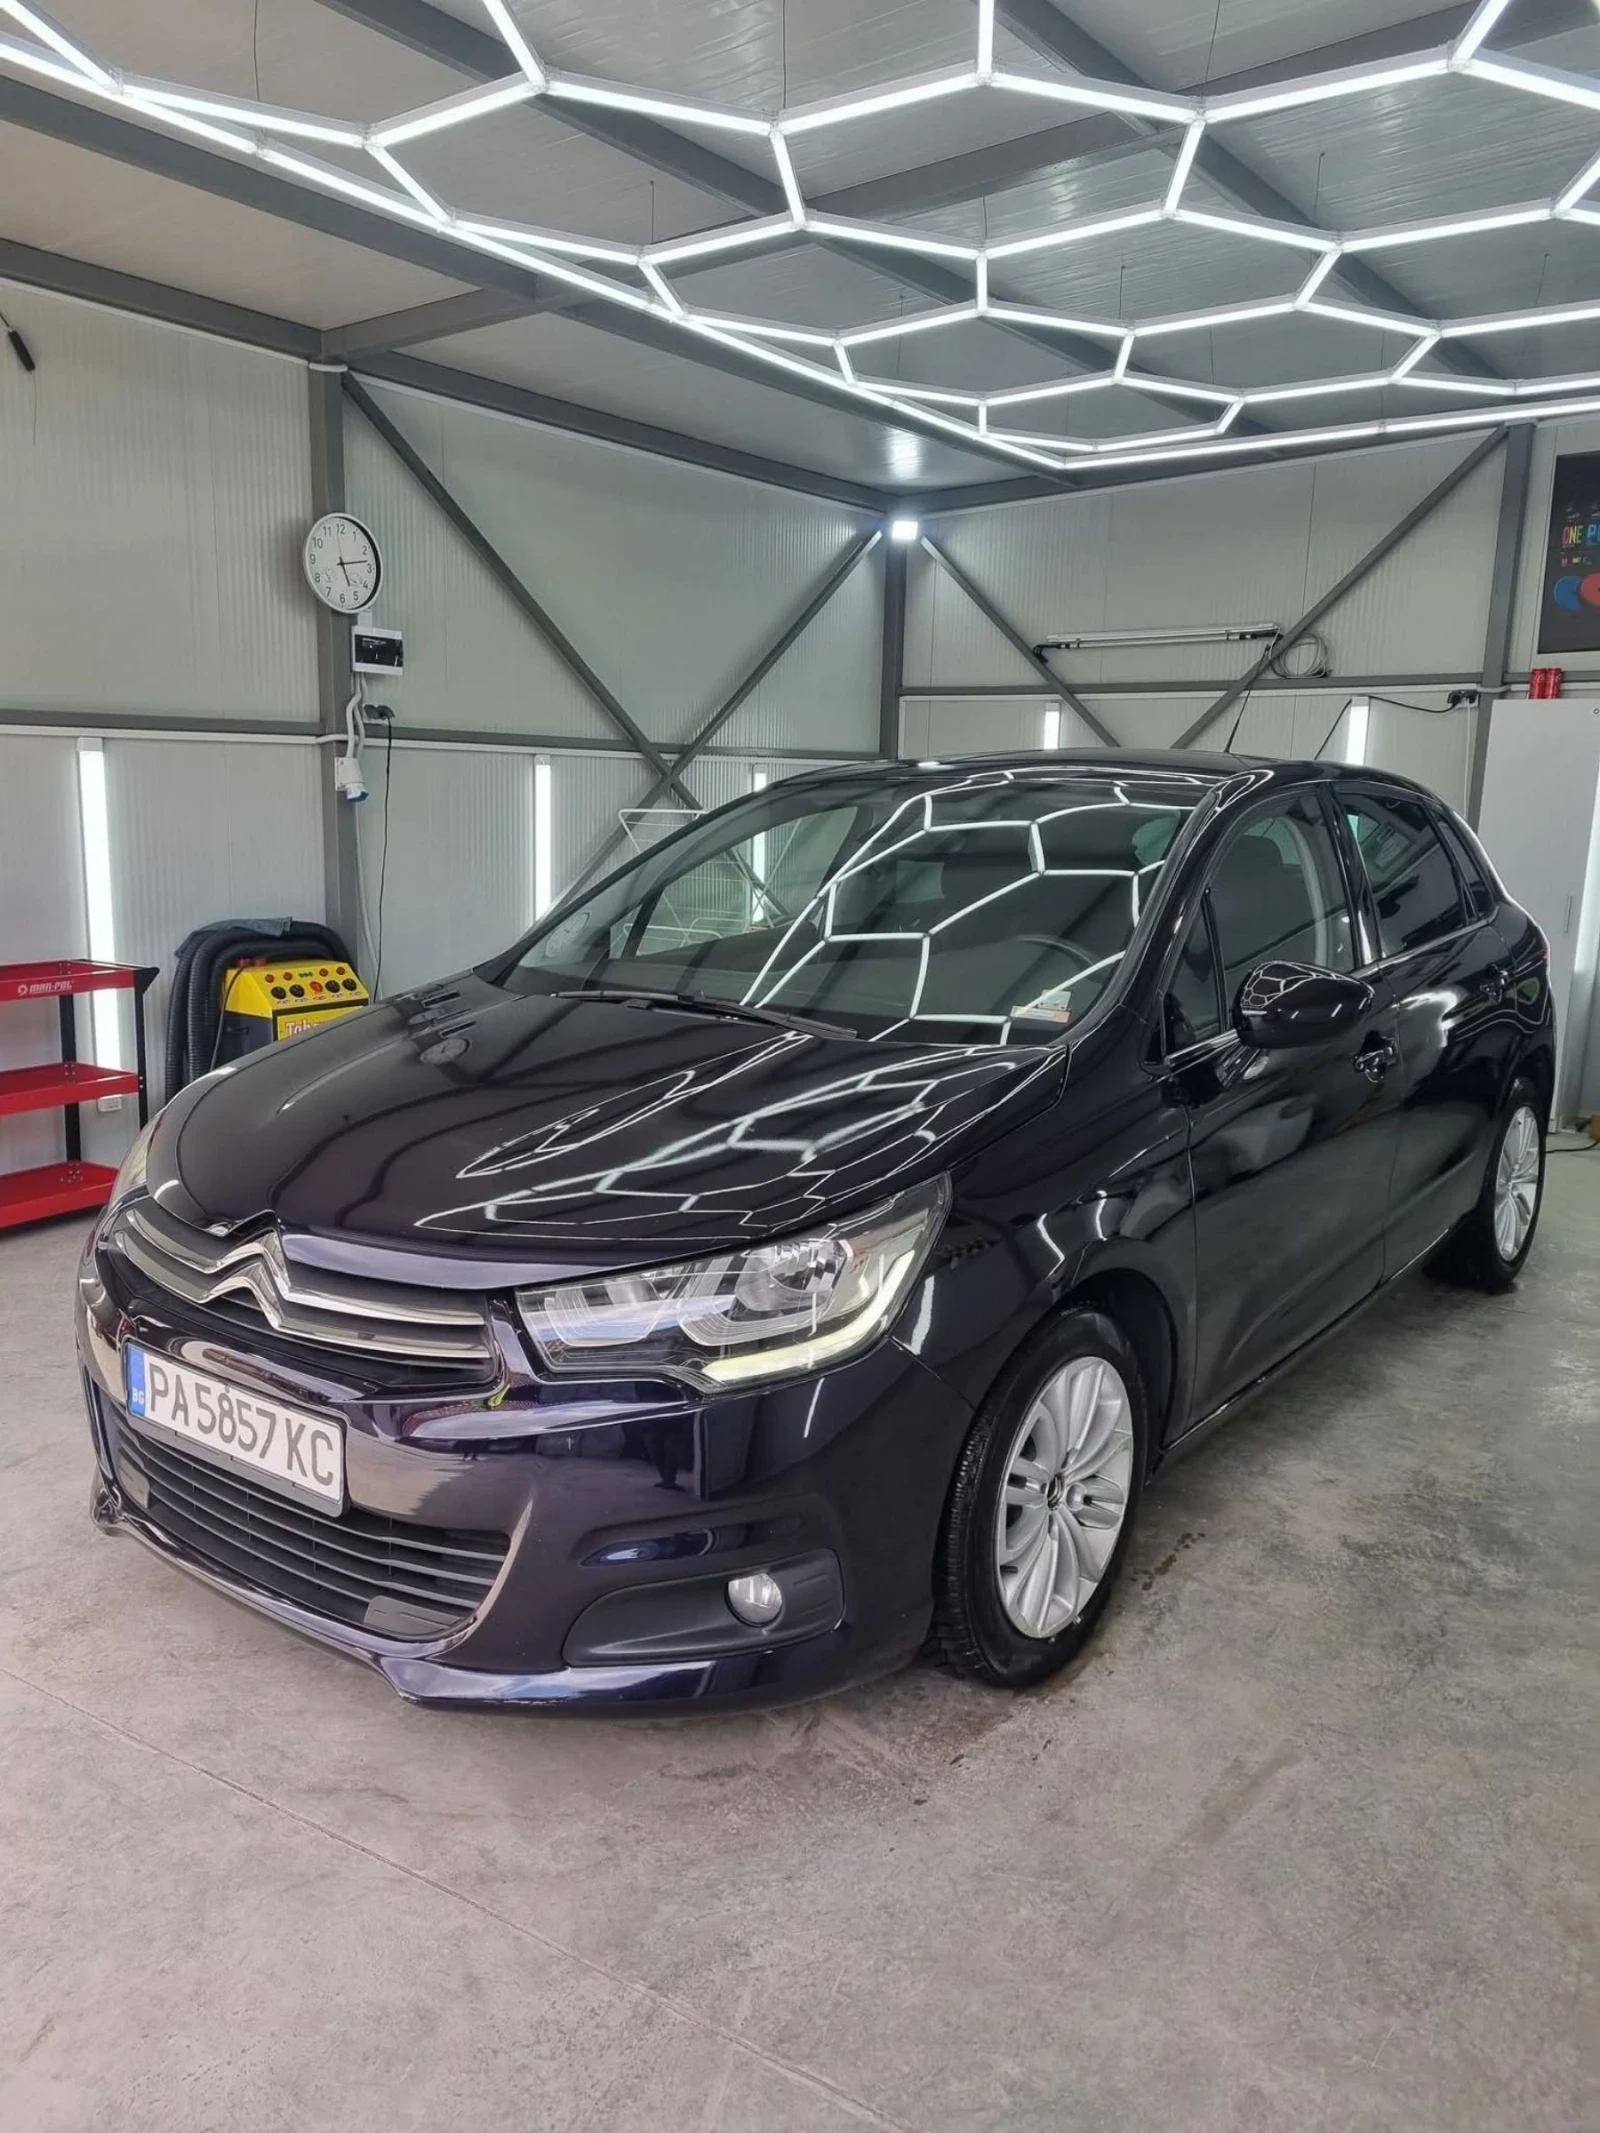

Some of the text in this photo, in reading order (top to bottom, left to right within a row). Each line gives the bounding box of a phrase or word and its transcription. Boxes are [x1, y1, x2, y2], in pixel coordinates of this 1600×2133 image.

[323, 526, 332, 537] 11
[336, 523, 346, 535] 12
[352, 531, 357, 542] 1
[1562, 525, 1584, 545] ONE
[312, 537, 323, 549] 10
[362, 545, 368, 555] 2
[309, 553, 316, 564] 9
[367, 563, 372, 574] 3
[314, 572, 321, 583] 8
[362, 580, 368, 590] 4
[325, 586, 332, 598] 7
[353, 590, 359, 601] 5
[339, 593, 346, 604] 6
[132, 1387, 145, 1404] BG
[285, 1417, 334, 1487] KC
